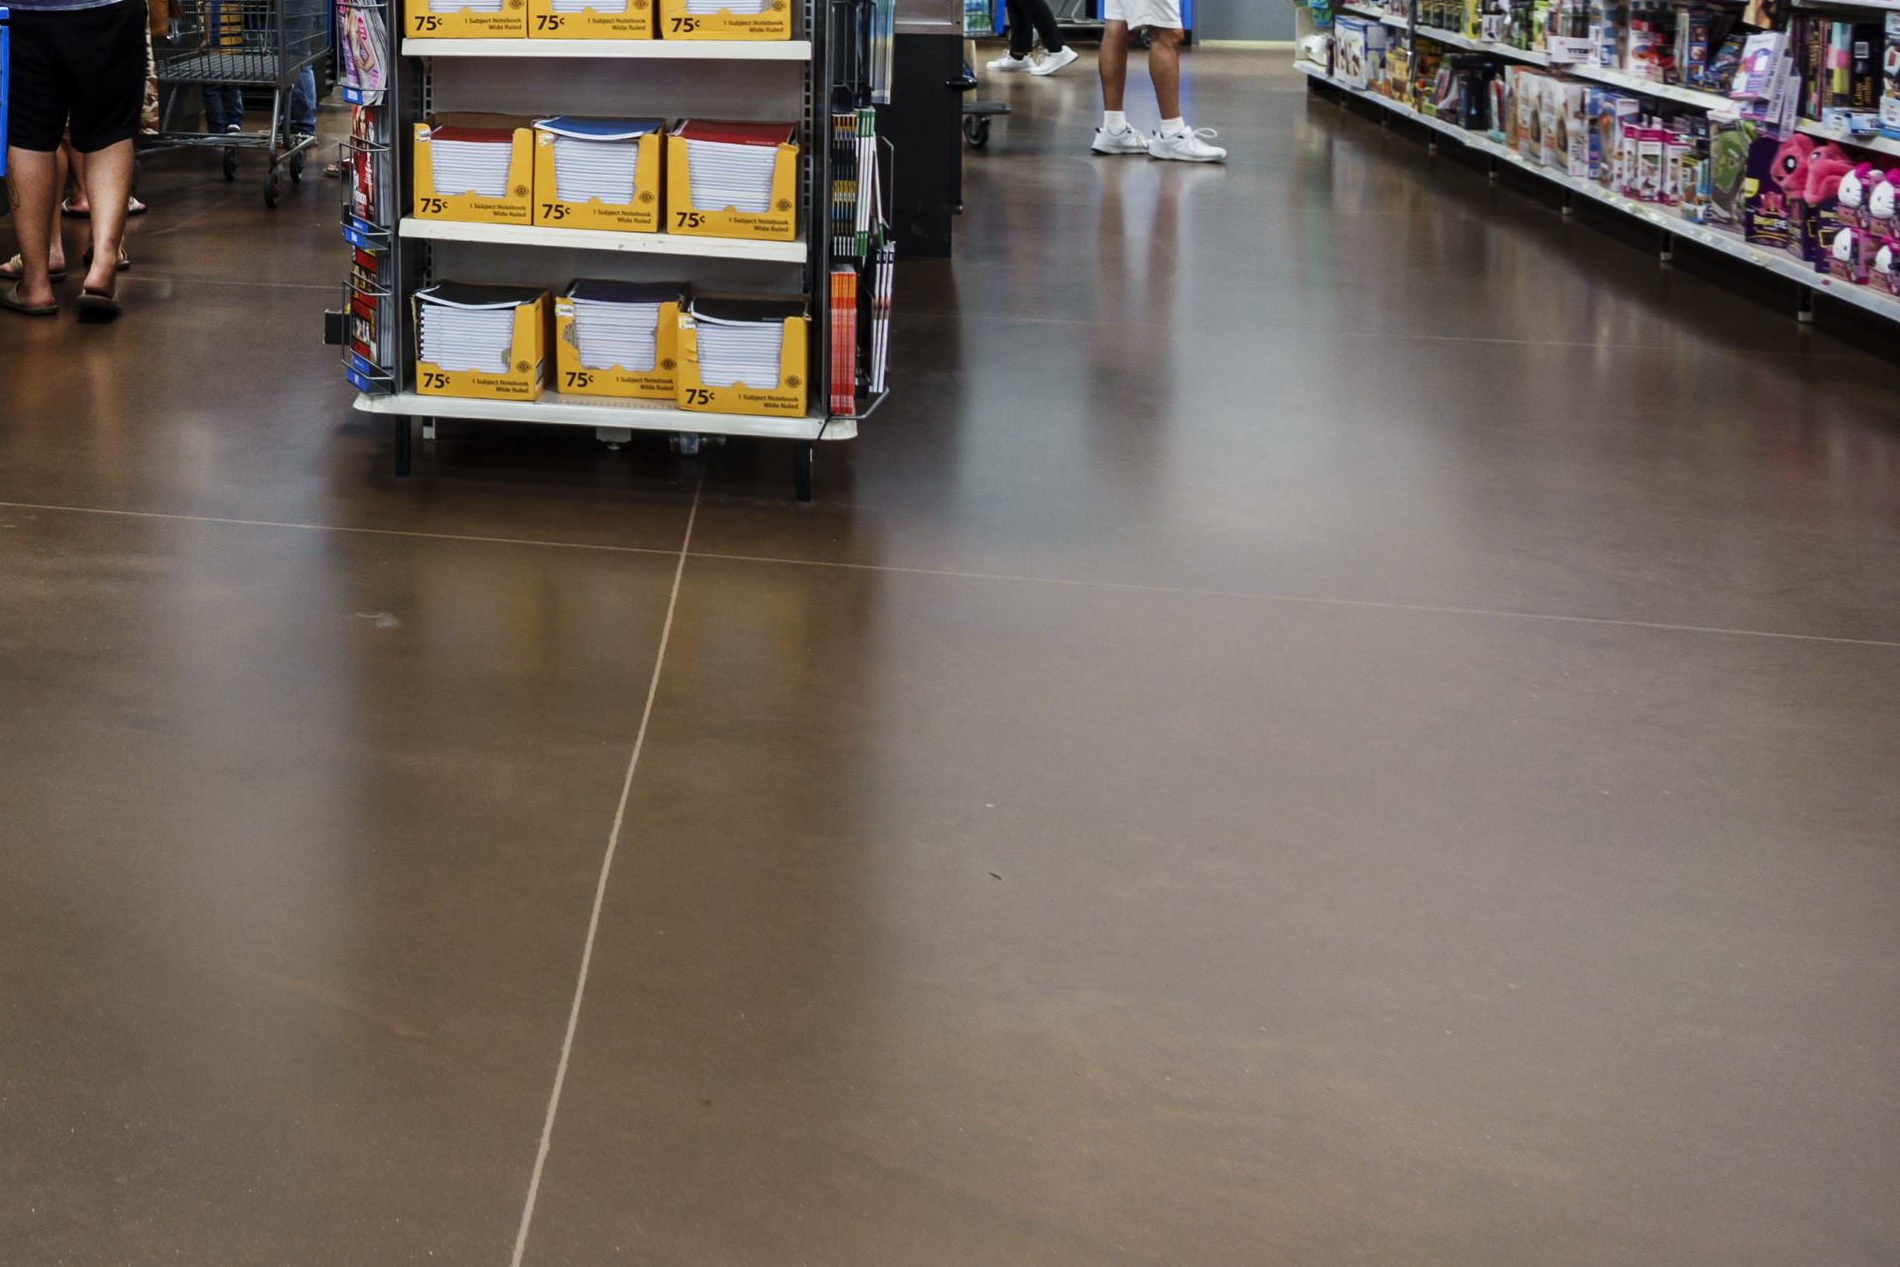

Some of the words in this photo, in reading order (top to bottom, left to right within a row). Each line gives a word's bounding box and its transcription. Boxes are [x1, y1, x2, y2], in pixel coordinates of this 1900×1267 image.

[414, 16, 442, 31] 75¢
[536, 15, 564, 30] 75¢
[592, 18, 615, 26] Subject
[671, 18, 700, 33] 75¢
[727, 20, 751, 28] Subject
[420, 198, 448, 213] 75¢
[473, 203, 496, 211] Subject
[542, 204, 570, 219] 75¢
[597, 209, 620, 218] Subject
[621, 210, 651, 218] Notebook
[676, 212, 705, 227] 75¢
[733, 217, 756, 226] Subject
[757, 218, 789, 226] Notebook
[753, 224, 769, 232] Wide
[423, 373, 450, 388] 75¢
[475, 379, 498, 387] Subject
[566, 372, 593, 387] 75¢
[620, 376, 643, 385] Subject
[643, 377, 674, 385] Notebook
[655, 384, 674, 392] Ruled
[686, 389, 715, 404] 75¢
[742, 394, 766, 402] Subject
[779, 402, 799, 410] Ruled
